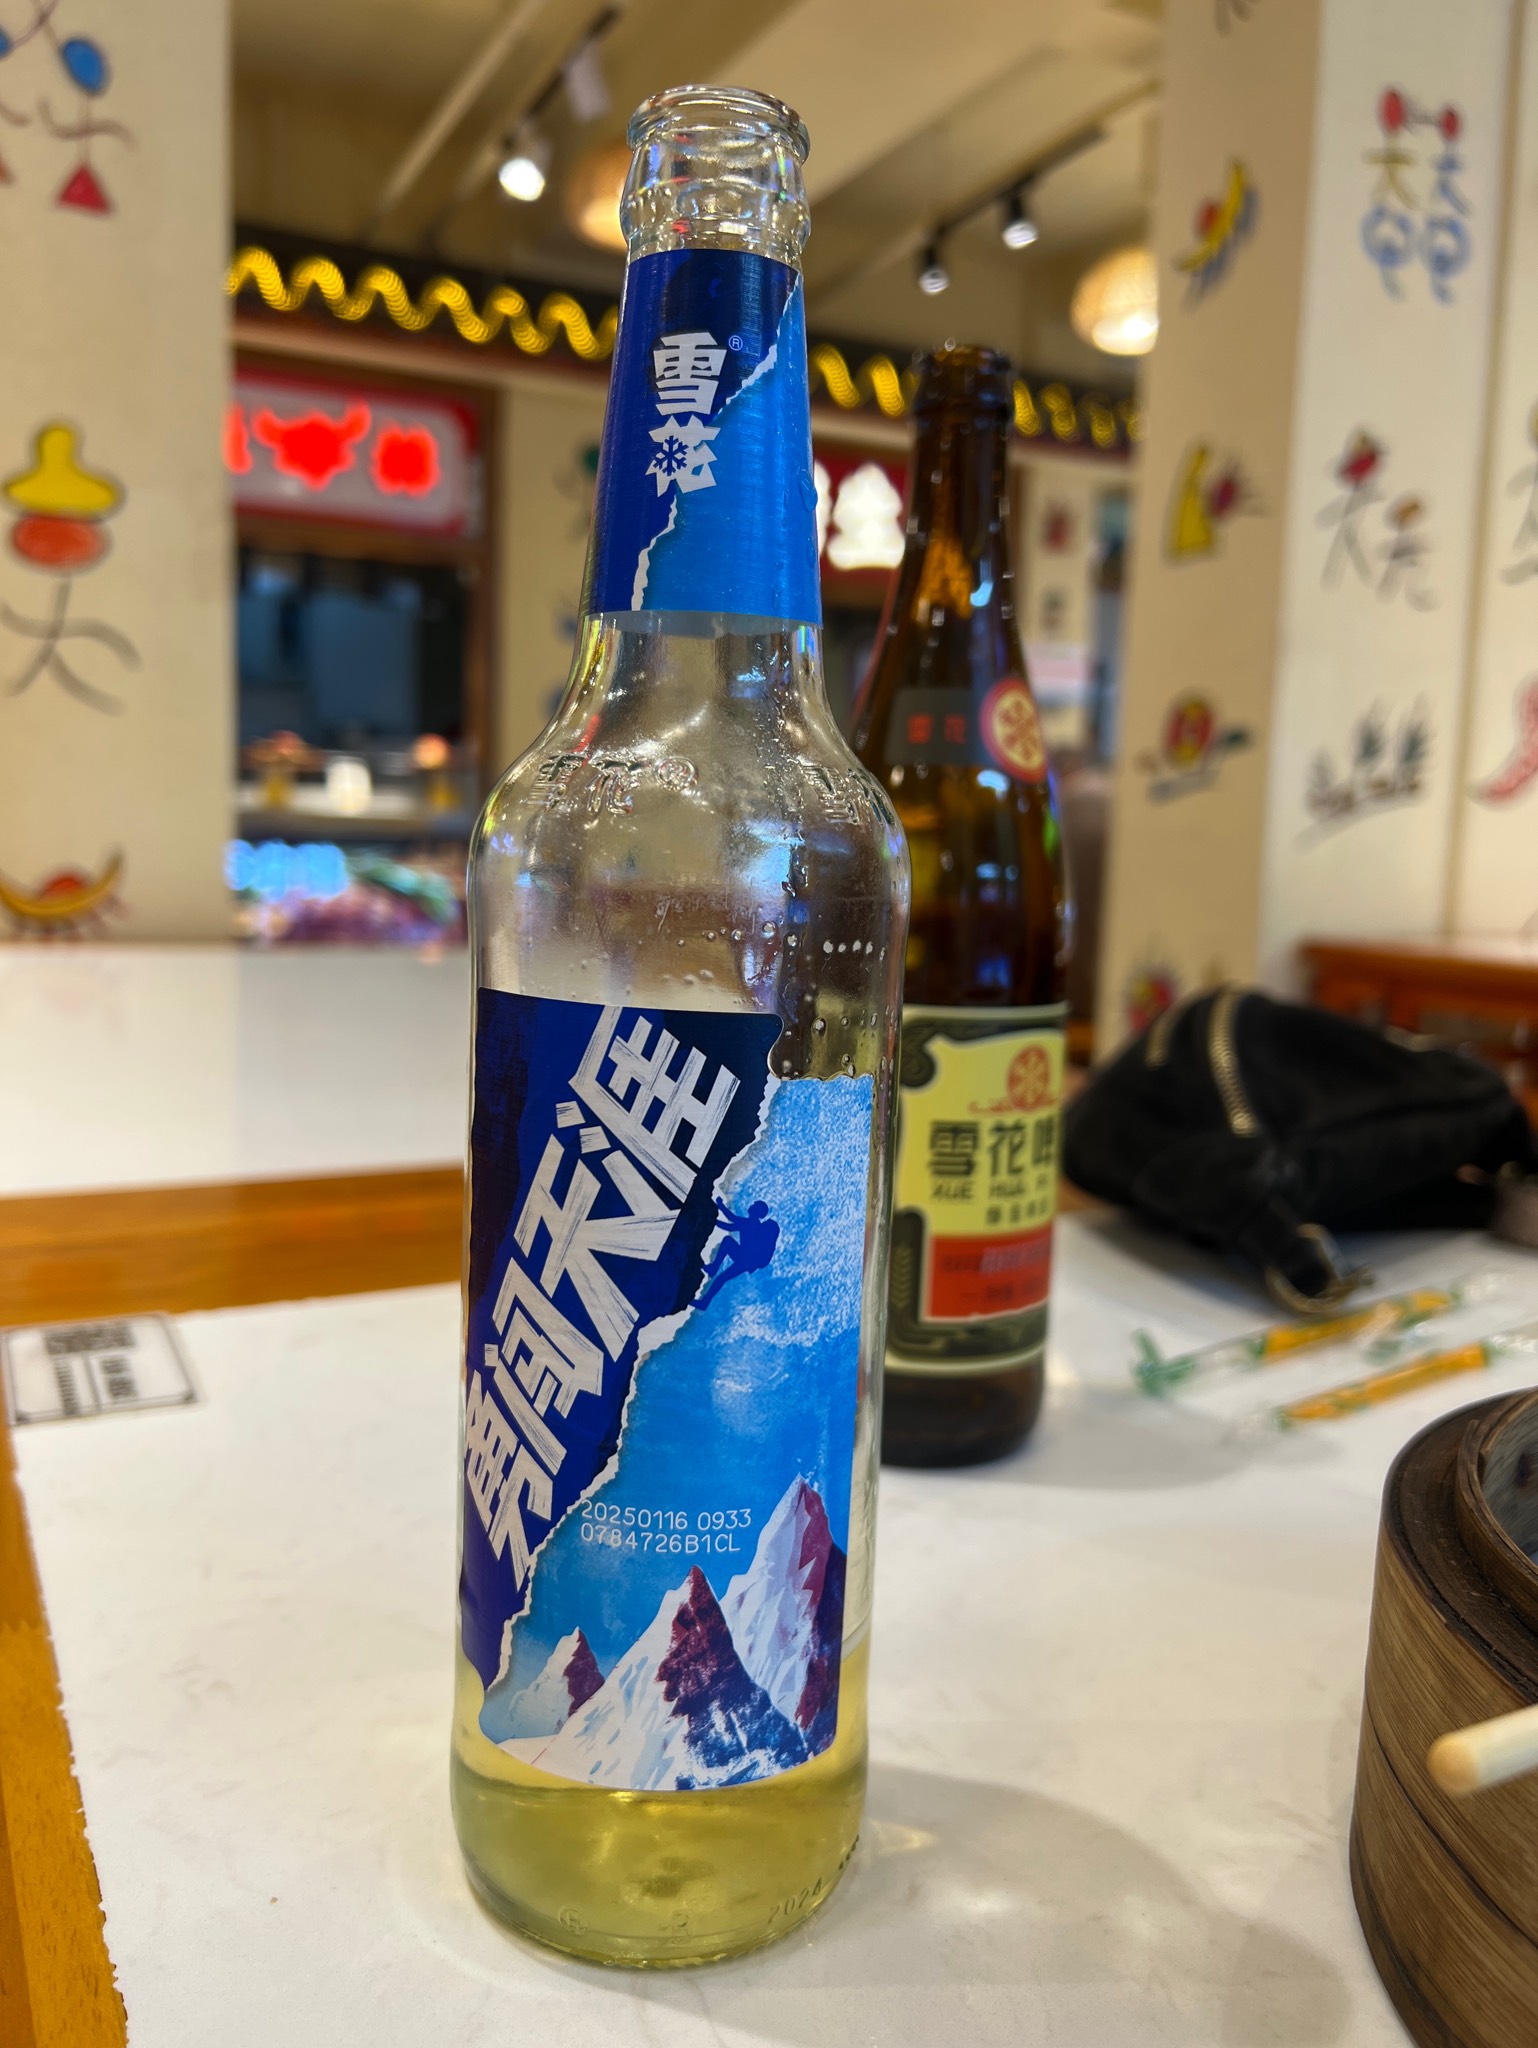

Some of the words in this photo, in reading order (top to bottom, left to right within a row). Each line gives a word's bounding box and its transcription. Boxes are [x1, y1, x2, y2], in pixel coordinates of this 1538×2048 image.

[645, 332, 728, 497] 雪花
[465, 1005, 740, 1599] 勇闯天涯
[580, 1522, 741, 1553] 0784726B1CL
[581, 1499, 688, 1530] 20250116
[697, 1508, 752, 1531] 0933
